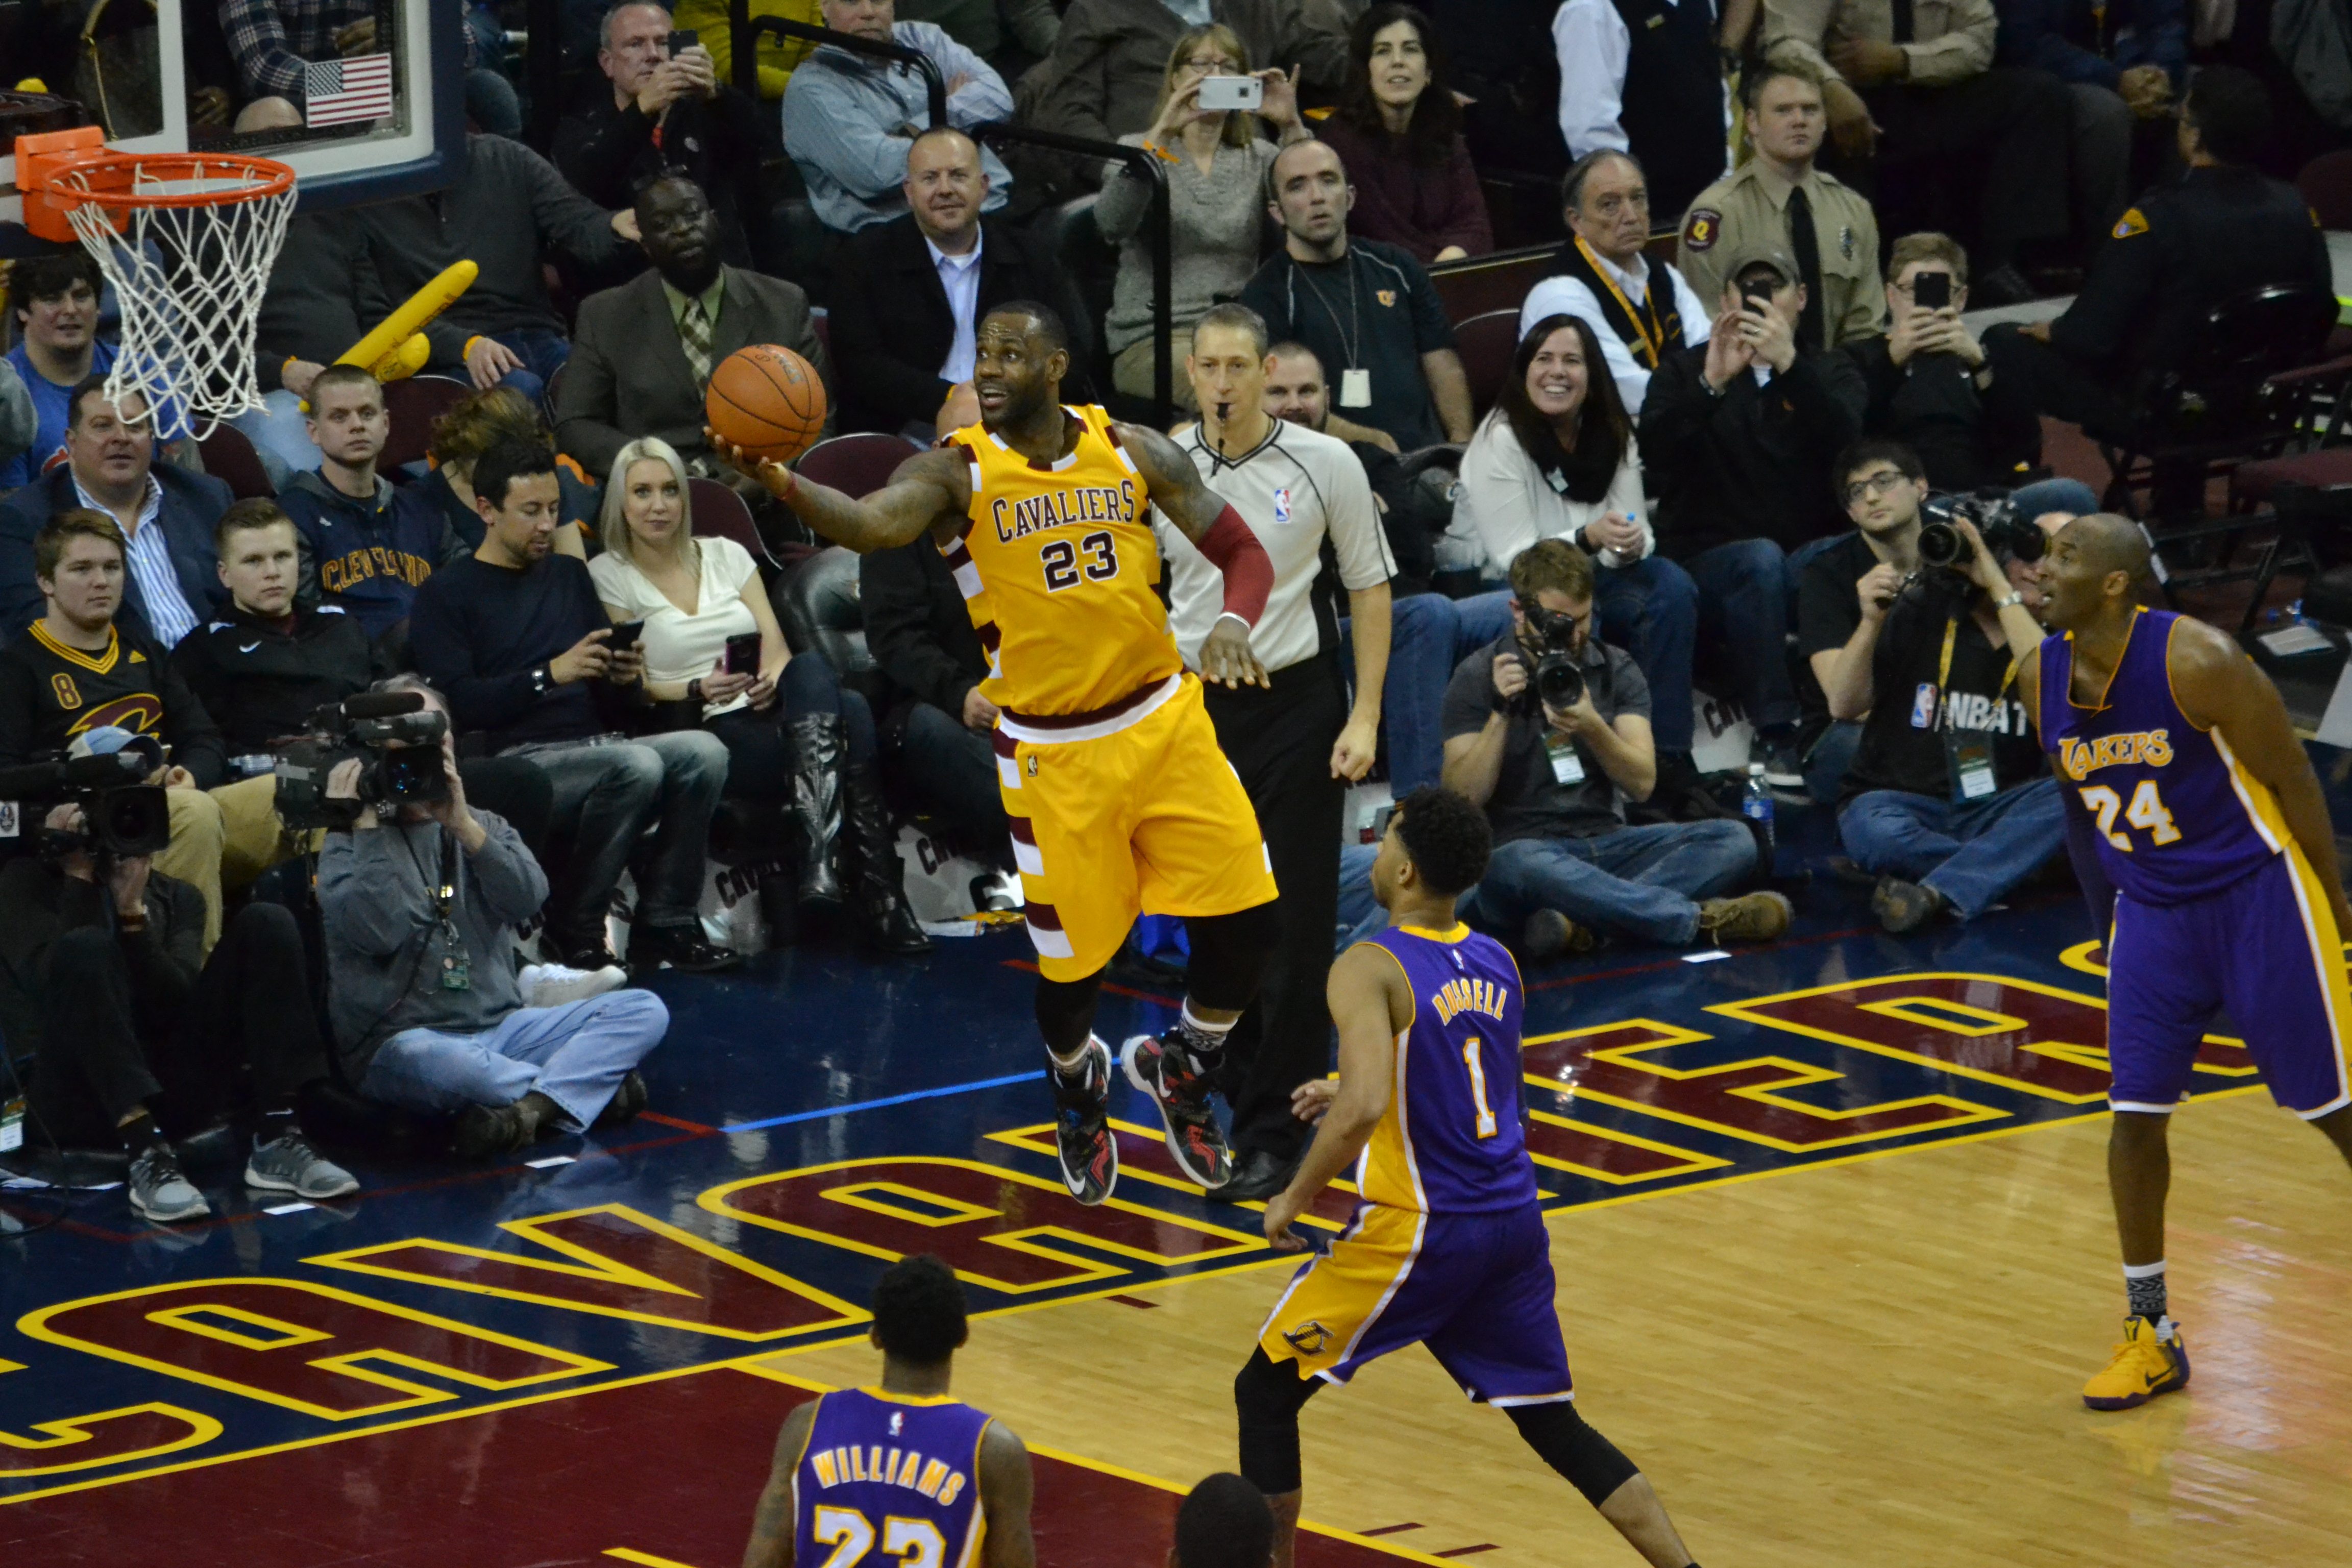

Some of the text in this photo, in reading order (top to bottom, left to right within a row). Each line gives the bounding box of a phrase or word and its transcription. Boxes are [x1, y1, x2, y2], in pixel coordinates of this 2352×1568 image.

[992, 479, 1135, 544] CAVALIERS
[1040, 530, 1119, 593] 23
[52, 672, 83, 709] 8
[2058, 728, 2174, 781] LAKERS
[2078, 779, 2183, 852] 24
[1432, 978, 1507, 1026] RUSSELL
[1463, 1037, 1498, 1139] 1
[812, 1445, 966, 1506] WILLIAMS
[814, 1505, 947, 1568] 23
